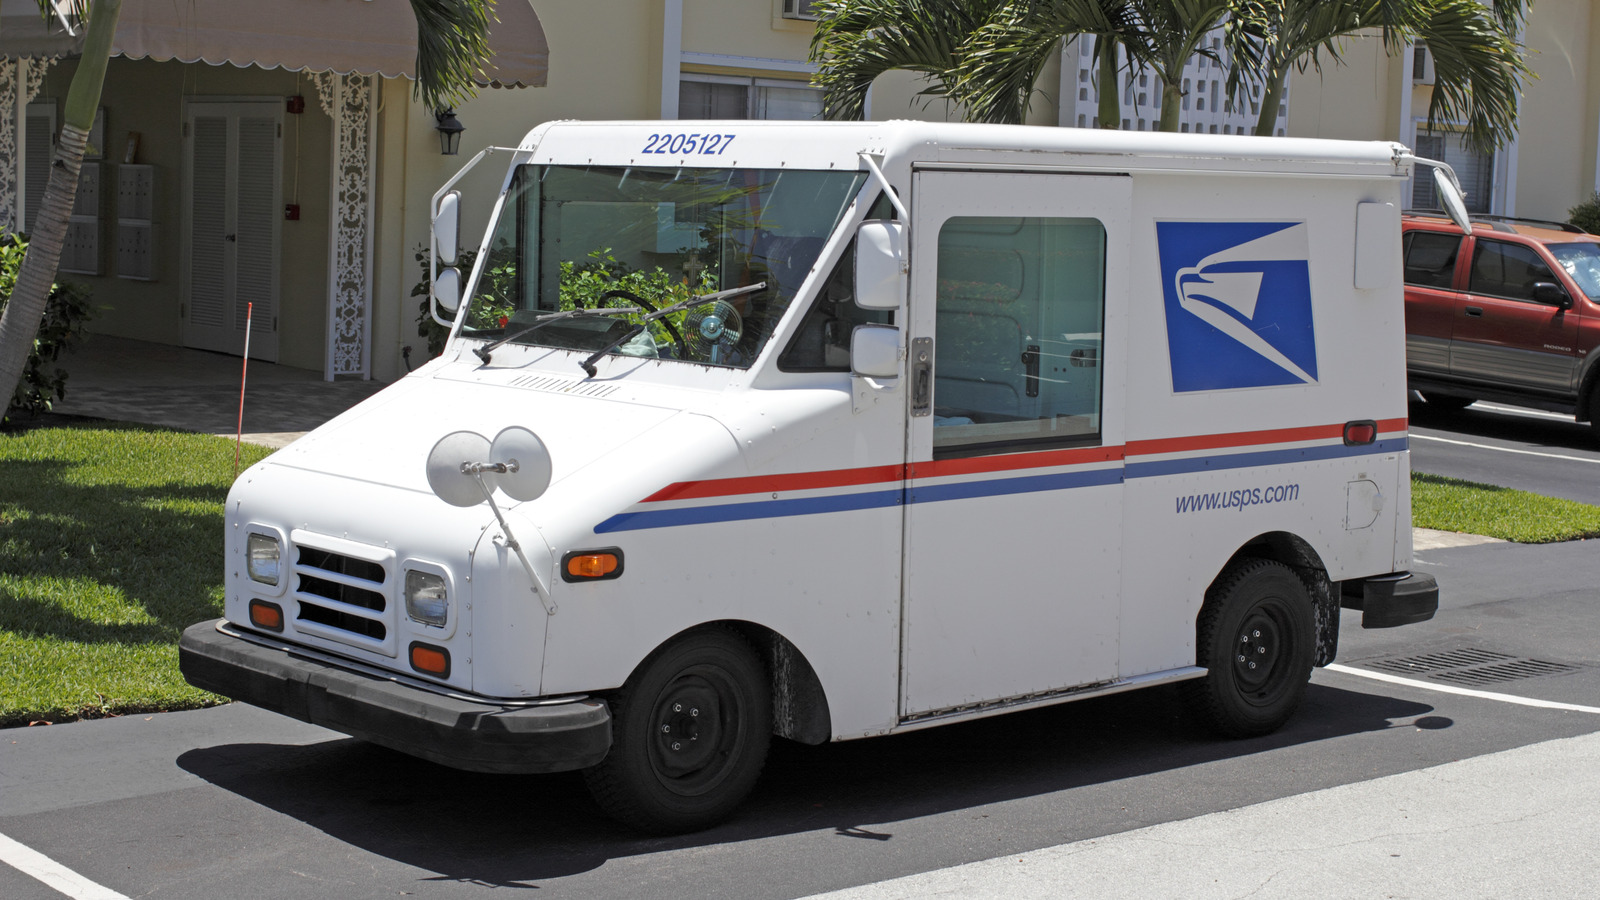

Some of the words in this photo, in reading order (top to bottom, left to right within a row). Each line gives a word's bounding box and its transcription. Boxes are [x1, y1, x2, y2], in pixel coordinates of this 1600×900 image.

[641, 133, 736, 155] 2205127
[1543, 343, 1572, 352] RODEO
[1176, 483, 1300, 514] www.usps.com
